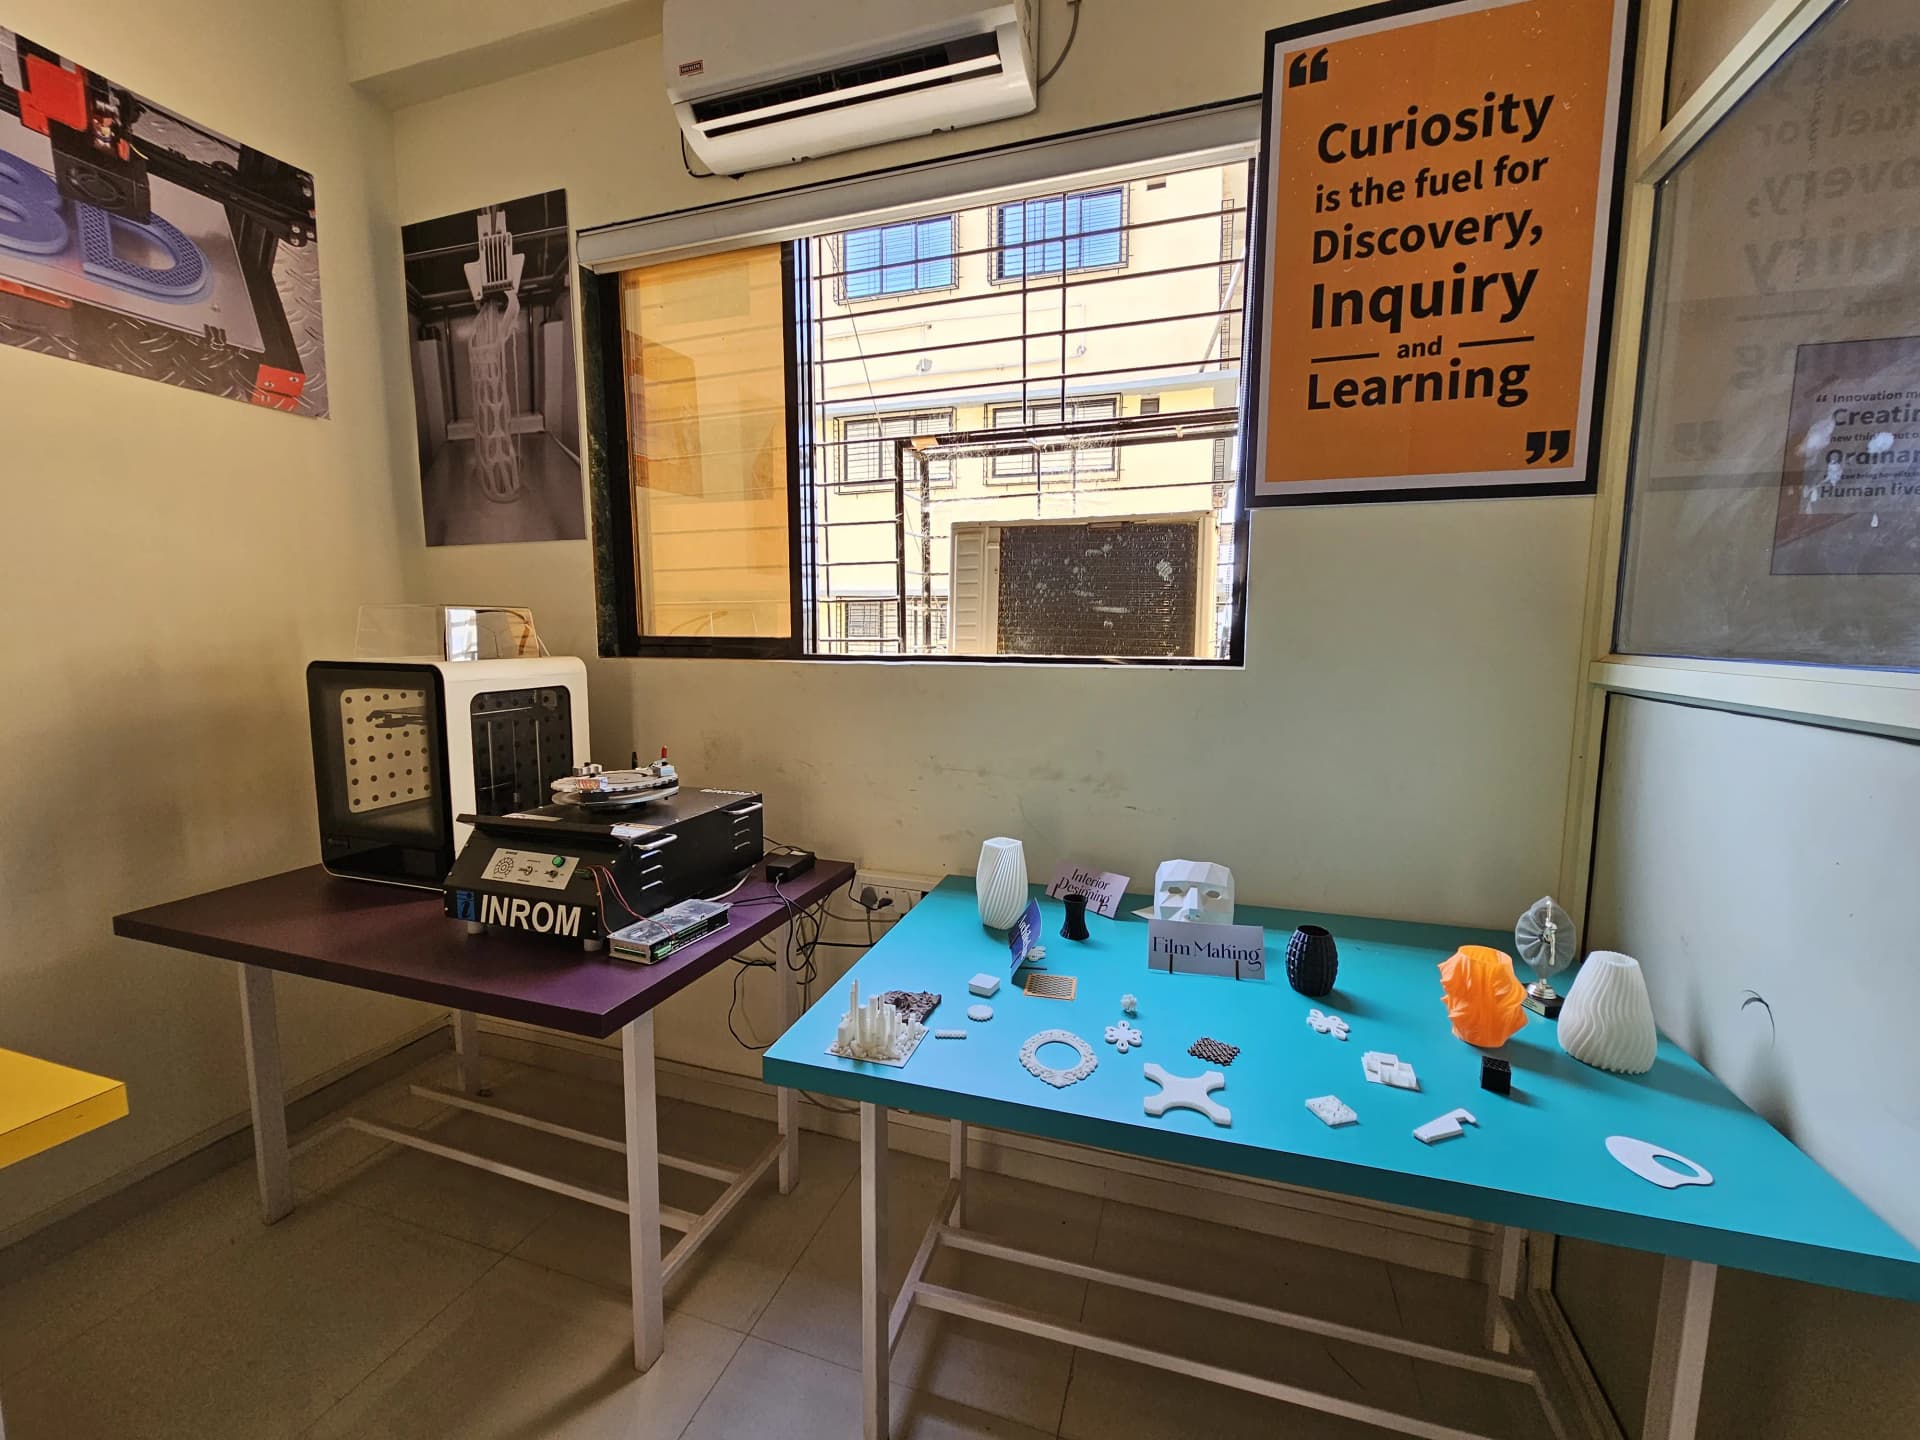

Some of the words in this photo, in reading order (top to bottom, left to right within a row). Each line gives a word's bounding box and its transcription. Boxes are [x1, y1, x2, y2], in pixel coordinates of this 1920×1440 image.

[1318, 91, 1554, 164] Curiosity
[1315, 184, 1340, 213] is
[1350, 177, 1405, 207] the
[1416, 159, 1483, 198] fuel
[1494, 155, 1549, 187] for
[1312, 209, 1543, 264] Discovery,
[1311, 263, 1539, 334] Inquiry
[1397, 336, 1443, 359] and
[1307, 358, 1531, 411] Learning
[1833, 390, 1903, 403] Innovation
[1820, 485, 1886, 498] Human
[1071, 868, 1110, 890] Interior
[480, 894, 582, 937] INROM
[1153, 936, 1190, 955] Film
[1194, 941, 1262, 972] Making
